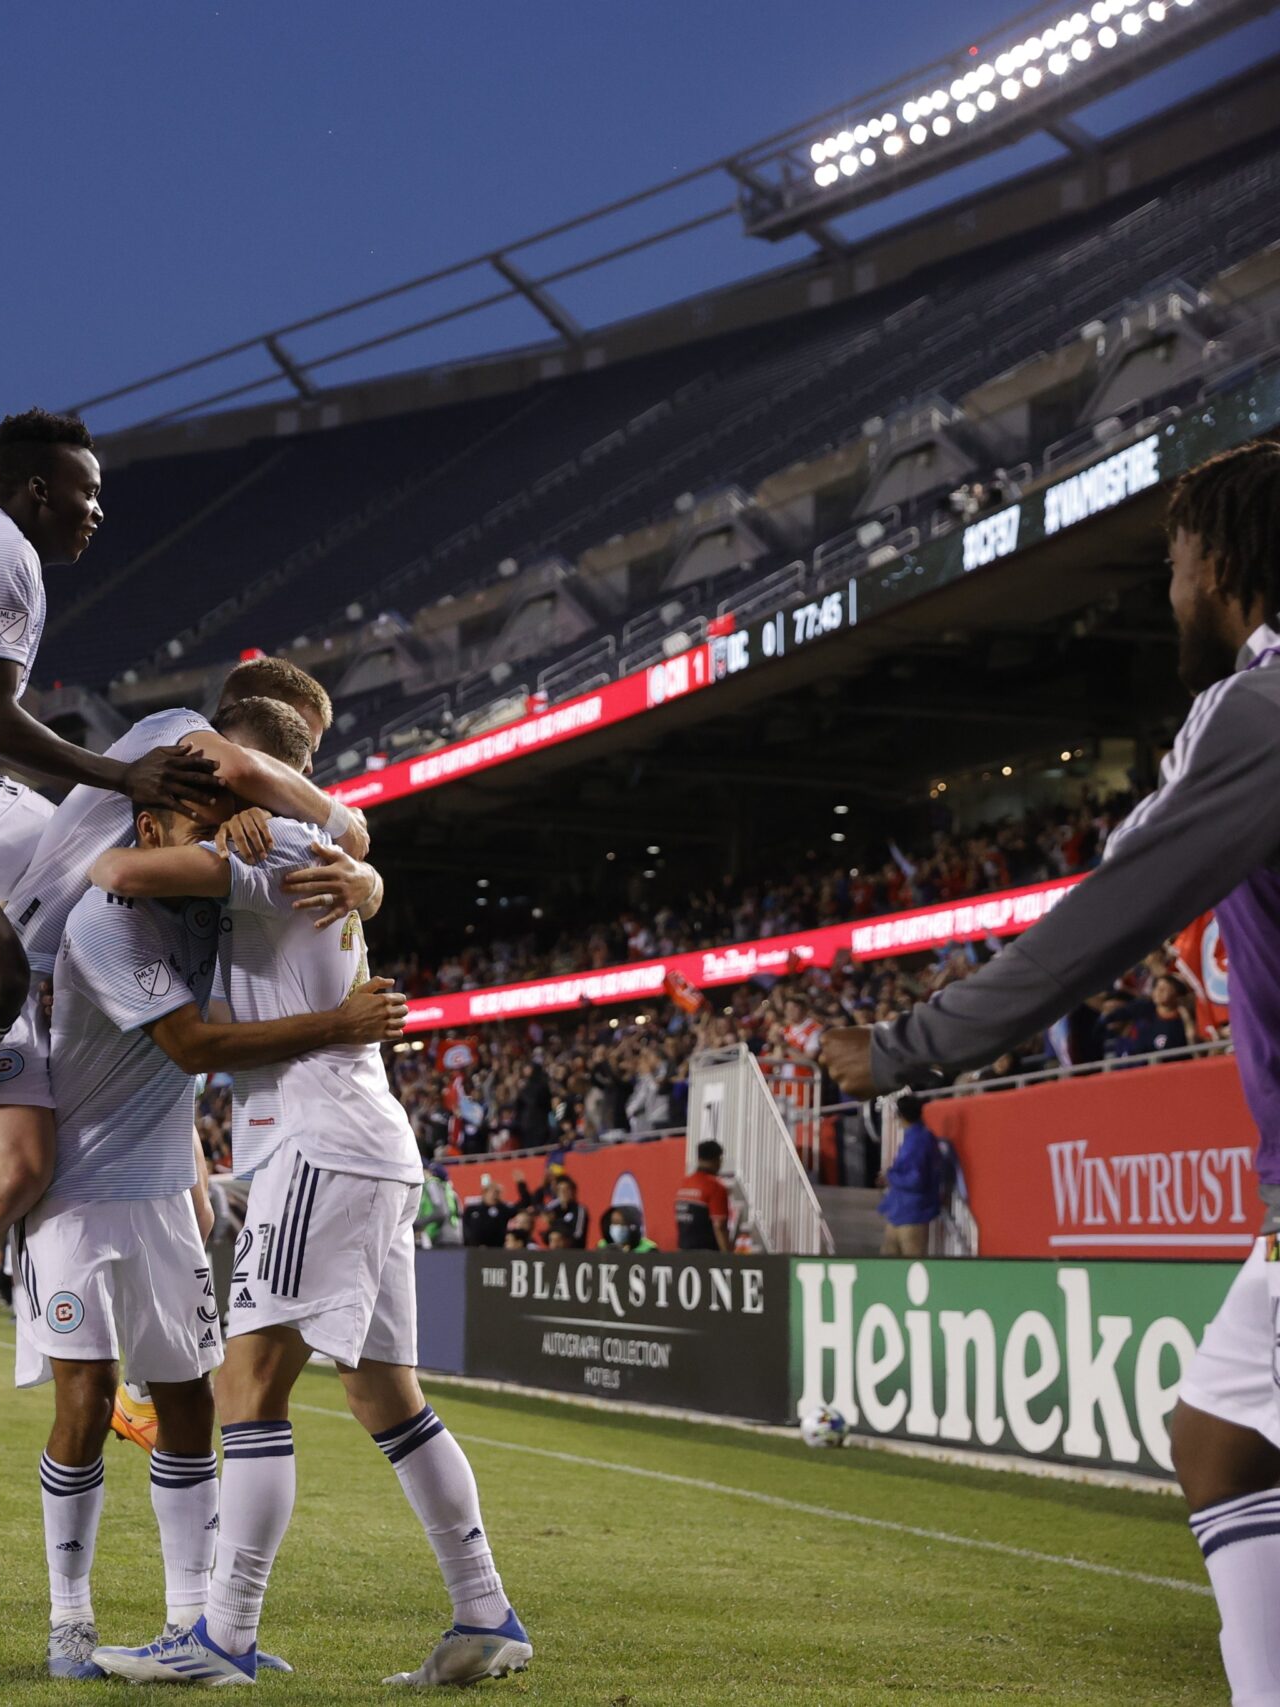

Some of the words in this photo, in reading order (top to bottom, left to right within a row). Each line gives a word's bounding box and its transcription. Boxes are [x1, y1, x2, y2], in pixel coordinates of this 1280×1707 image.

[1, 611, 16, 619] MLS
[692, 651, 704, 684] 1
[762, 621, 776, 657] 0
[137, 967, 155, 980] MLS
[1047, 1139, 1253, 1226] WINTRUST
[482, 1267, 507, 1287] THE
[510, 1260, 764, 1317] BLACKSTONE
[234, 1300, 256, 1308] adidas
[199, 1340, 217, 1349] adidas
[542, 1331, 601, 1359] AUTOGRAPH
[602, 1338, 672, 1368] COLLECTION
[584, 1367, 620, 1389] HOTELS
[796, 1262, 1200, 1472] Heineke
